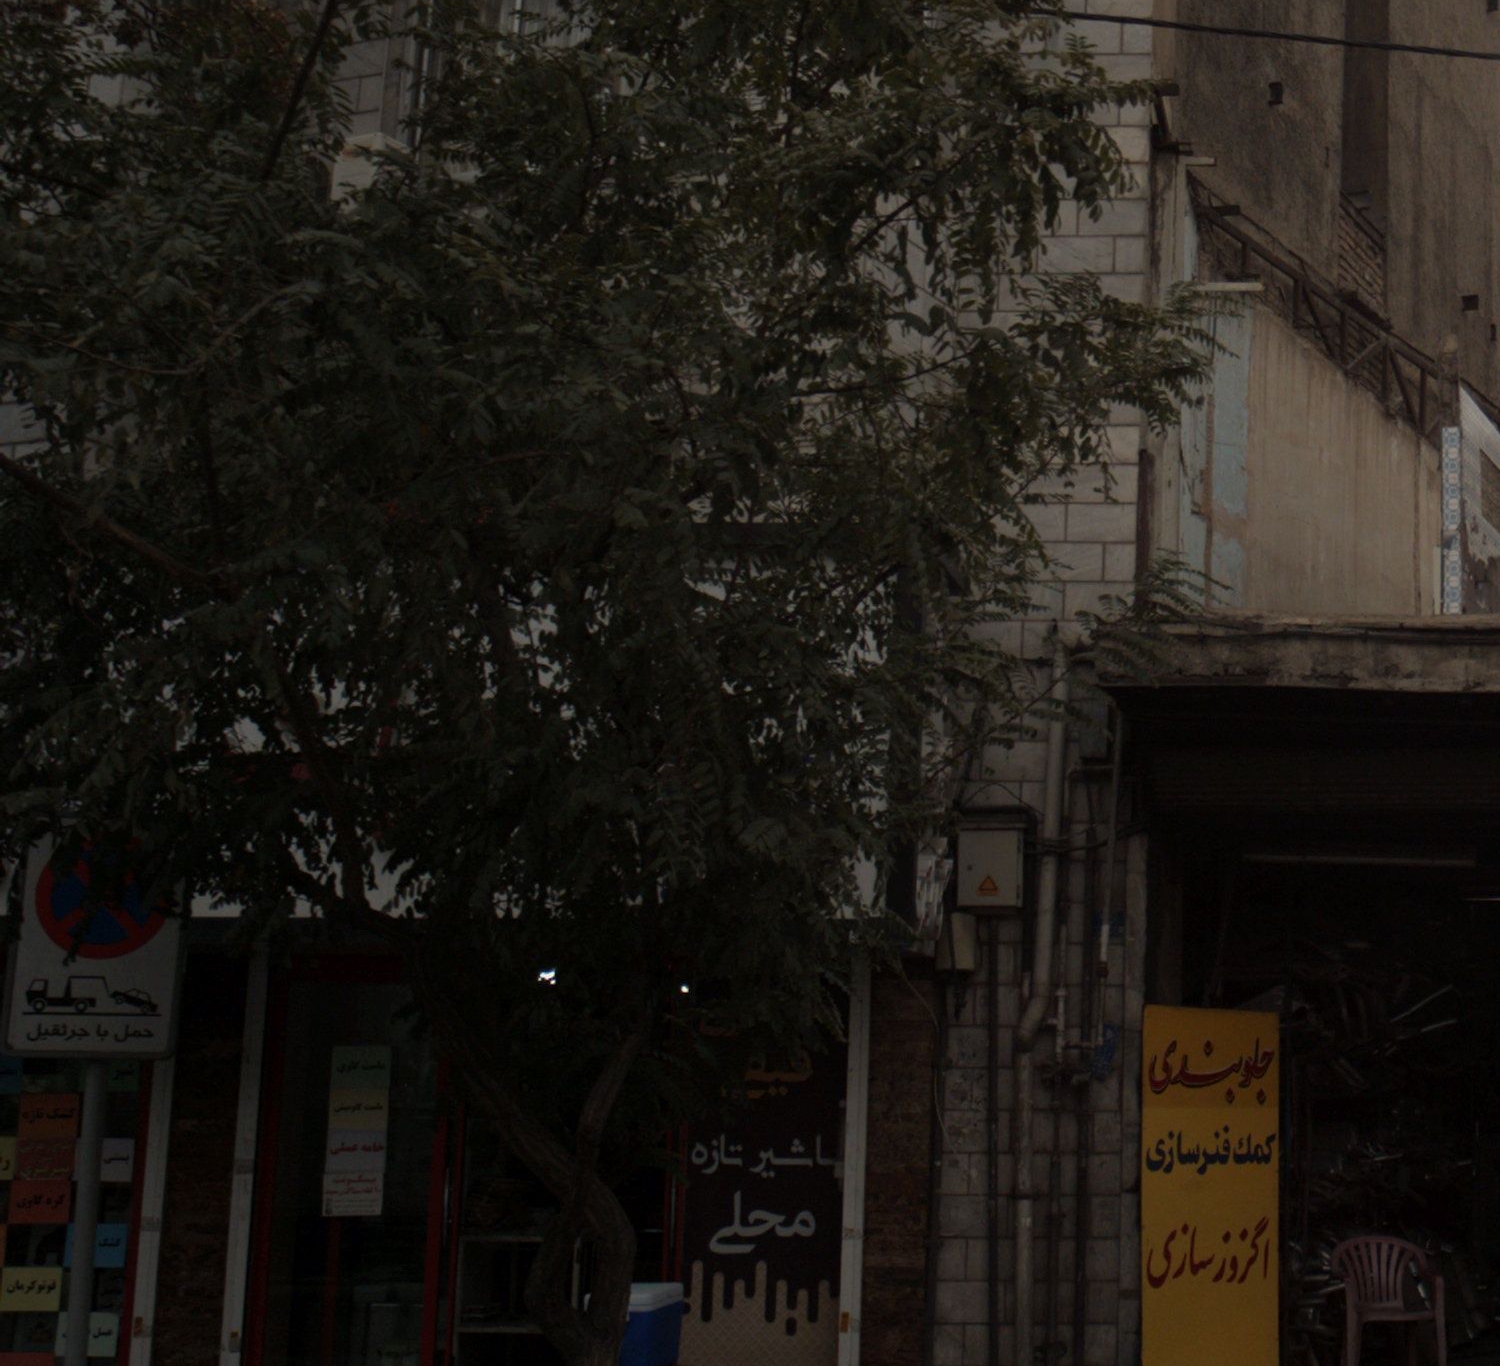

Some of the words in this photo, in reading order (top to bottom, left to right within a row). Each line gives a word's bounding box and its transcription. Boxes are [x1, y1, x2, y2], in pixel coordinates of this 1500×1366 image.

[27, 1023, 90, 1041] جرثقیل
[96, 1025, 109, 1041] با
[114, 1025, 154, 1042] حمل
[1149, 1037, 1274, 1105] جلوبندی
[690, 1133, 743, 1175] تازه
[708, 1190, 817, 1255] محلی
